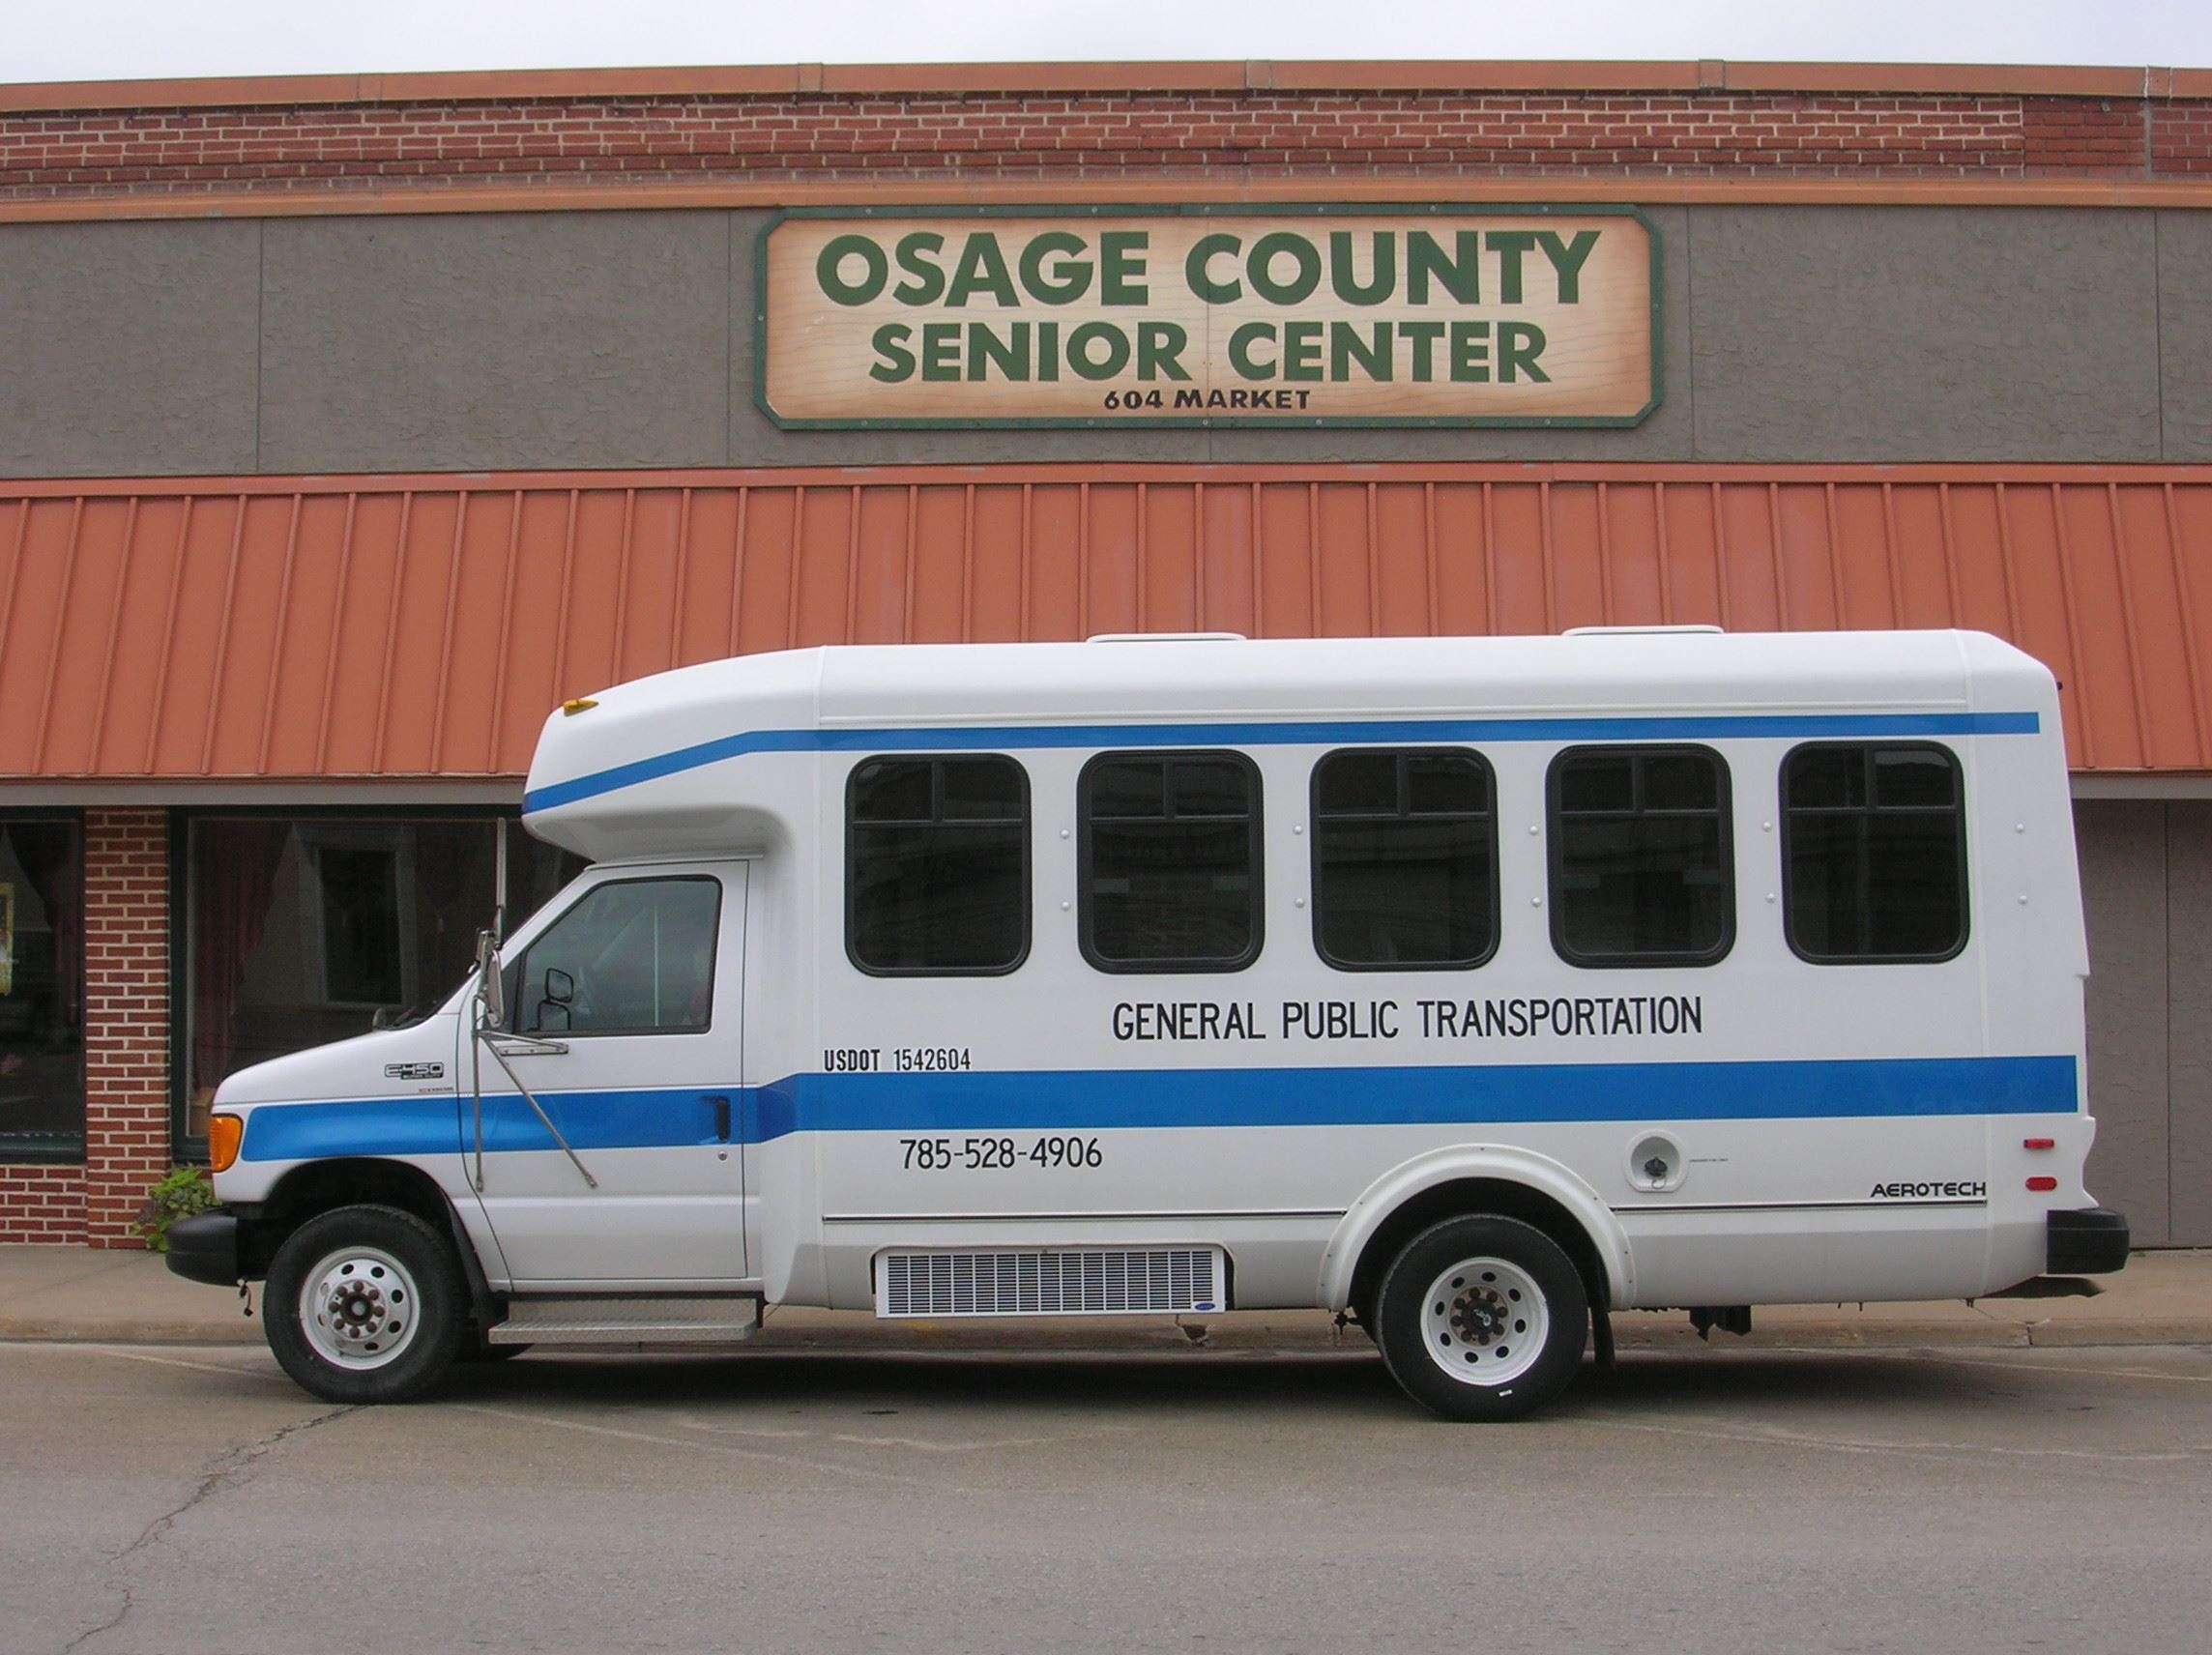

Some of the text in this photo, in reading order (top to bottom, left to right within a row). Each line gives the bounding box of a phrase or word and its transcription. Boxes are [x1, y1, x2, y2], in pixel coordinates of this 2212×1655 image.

[816, 230, 1602, 307] OSAGE COUNTY
[868, 320, 1553, 384] SENIOR CENTER
[1103, 389, 1310, 410] 604 MARKET
[1113, 996, 1703, 1041] GENERAL PUBLIC TRANSPORTATION
[824, 1048, 971, 1071] USDOT 1542604
[900, 1136, 1103, 1170] 785-528-4906
[1870, 1181, 1987, 1198] AEROTECH
